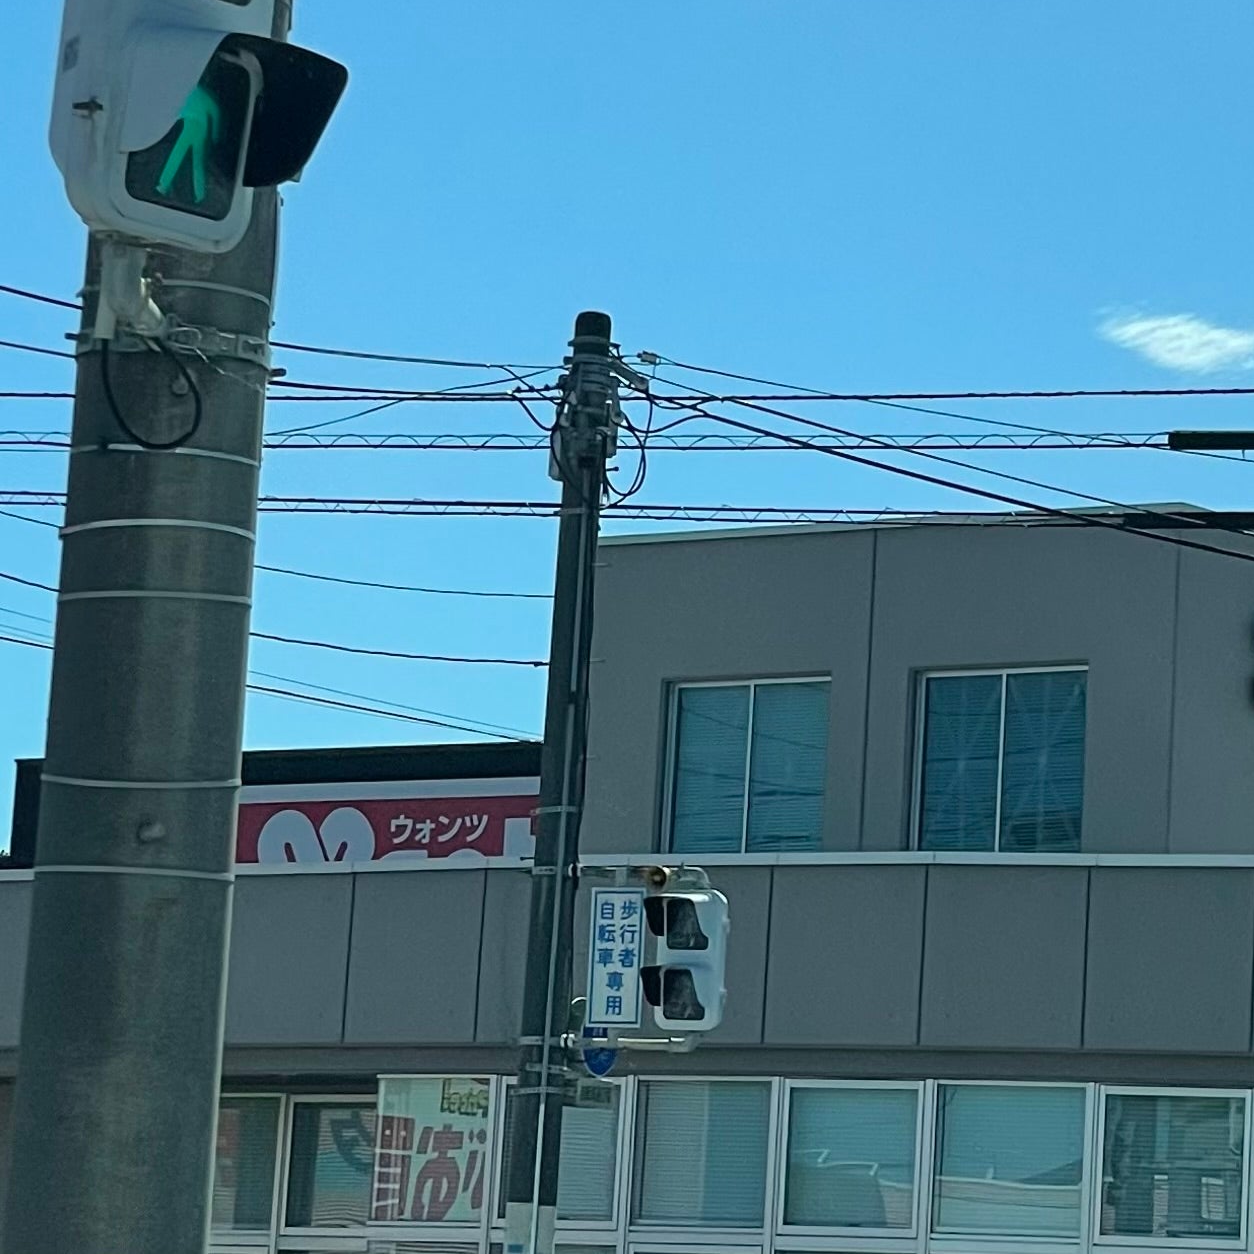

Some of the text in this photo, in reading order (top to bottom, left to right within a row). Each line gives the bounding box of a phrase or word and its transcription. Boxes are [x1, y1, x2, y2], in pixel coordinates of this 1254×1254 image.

[390, 814, 489, 843] ウォンツ
[597, 900, 616, 968] 自転車
[618, 900, 639, 968] 歩行者
[605, 971, 624, 1016] 専用
